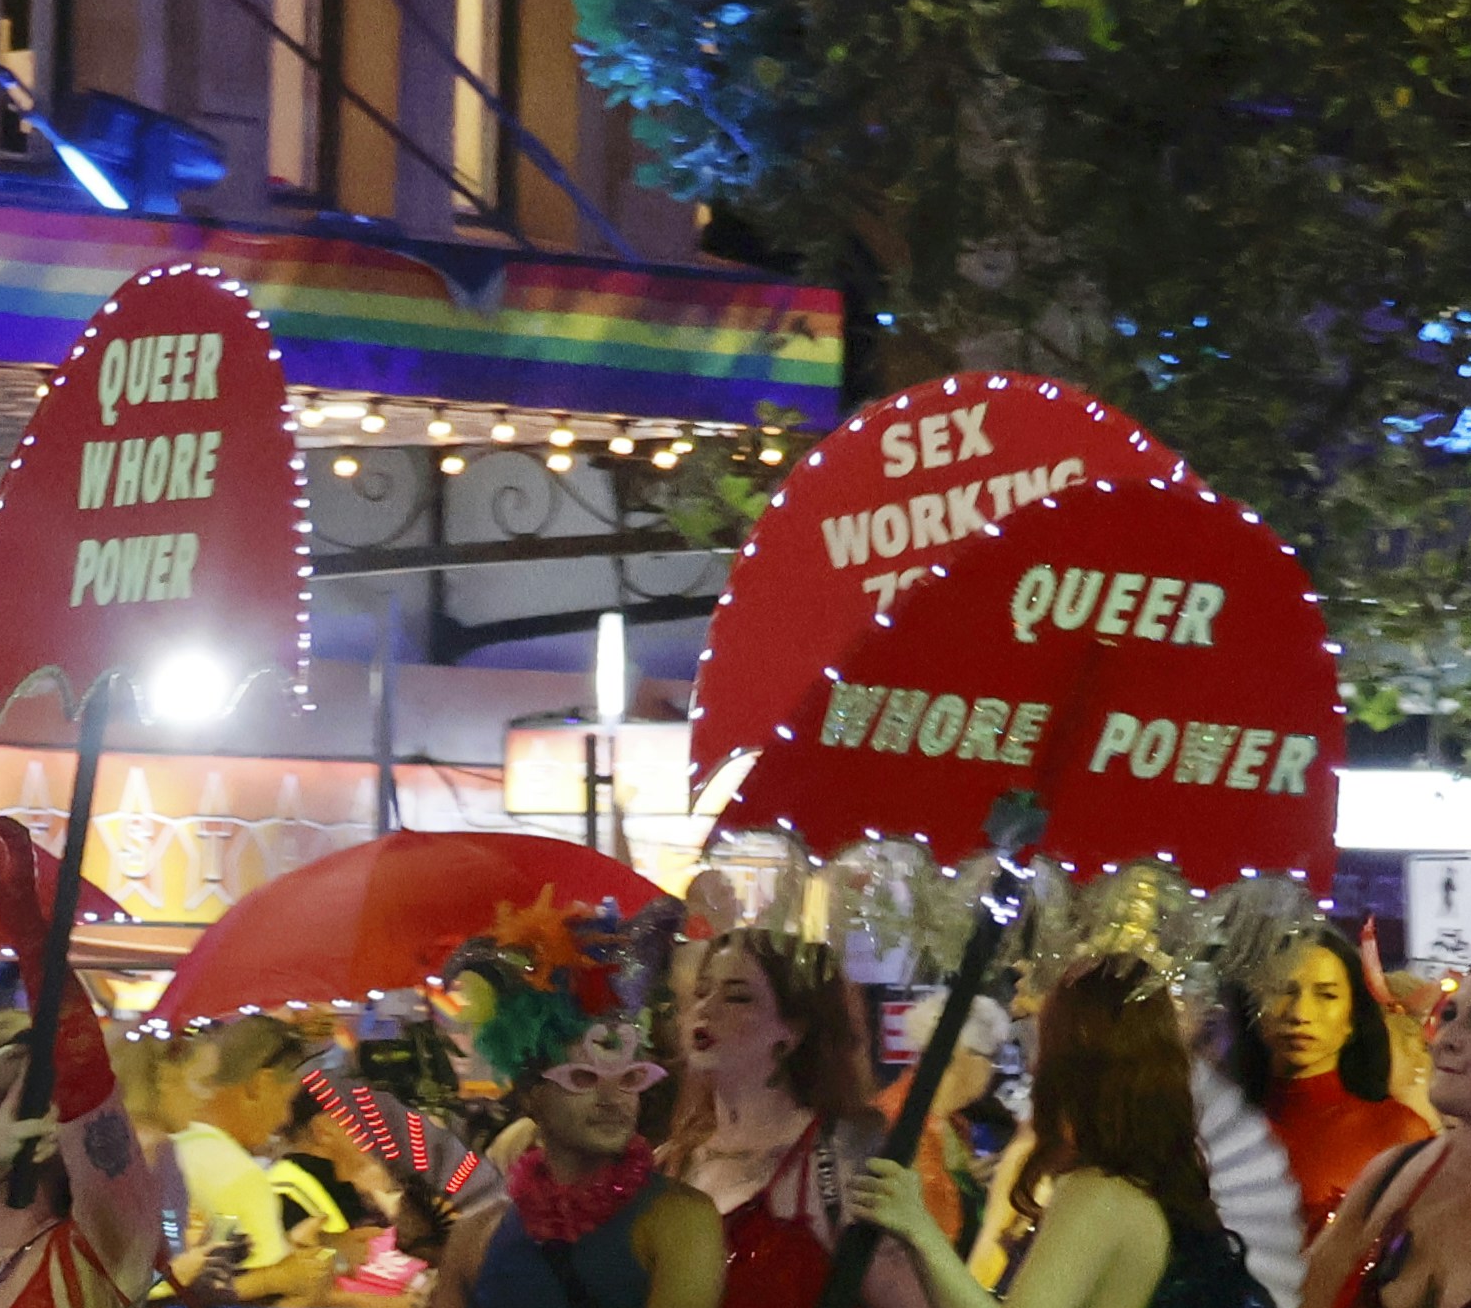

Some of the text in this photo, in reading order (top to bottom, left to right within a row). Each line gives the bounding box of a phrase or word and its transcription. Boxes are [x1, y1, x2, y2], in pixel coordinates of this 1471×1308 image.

[98, 333, 224, 426] QUEER
[78, 430, 223, 510] WHORE
[880, 401, 995, 478] SEX
[70, 532, 200, 608] POWER
[1010, 562, 1227, 647] QUEER
[820, 681, 1319, 796] WHORE POWER
